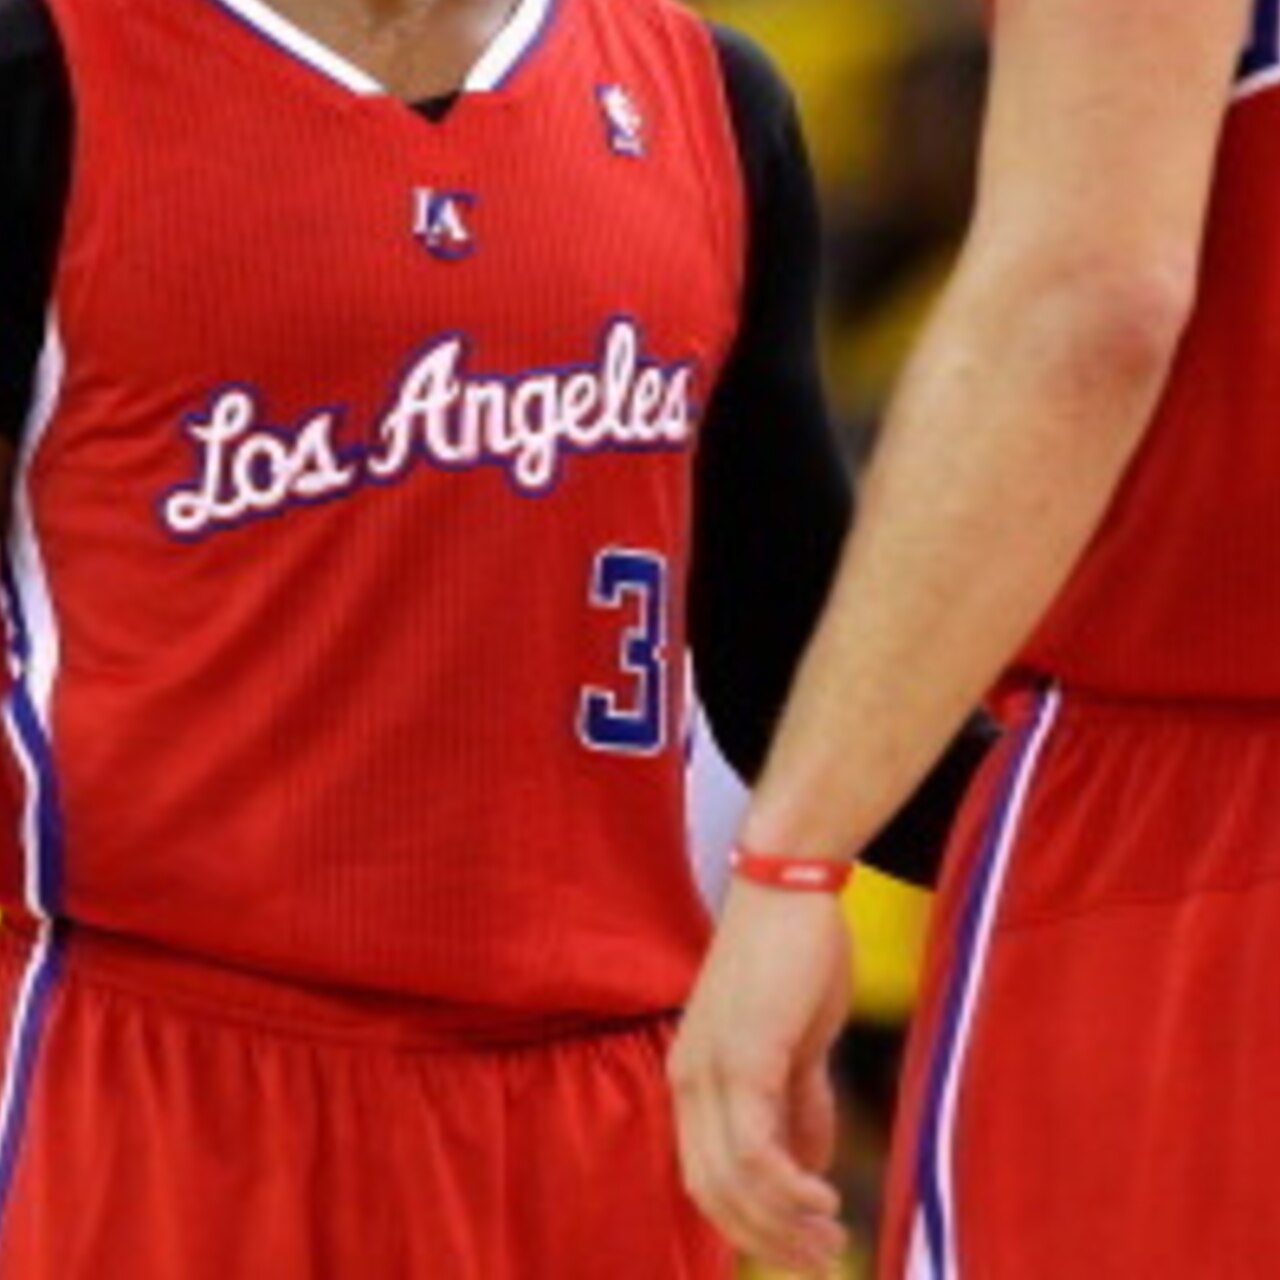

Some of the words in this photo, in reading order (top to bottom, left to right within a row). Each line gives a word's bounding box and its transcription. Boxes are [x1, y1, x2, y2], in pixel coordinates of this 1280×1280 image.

[164, 387, 356, 534] Los
[366, 318, 690, 492] Angeles
[576, 544, 667, 757] 3
